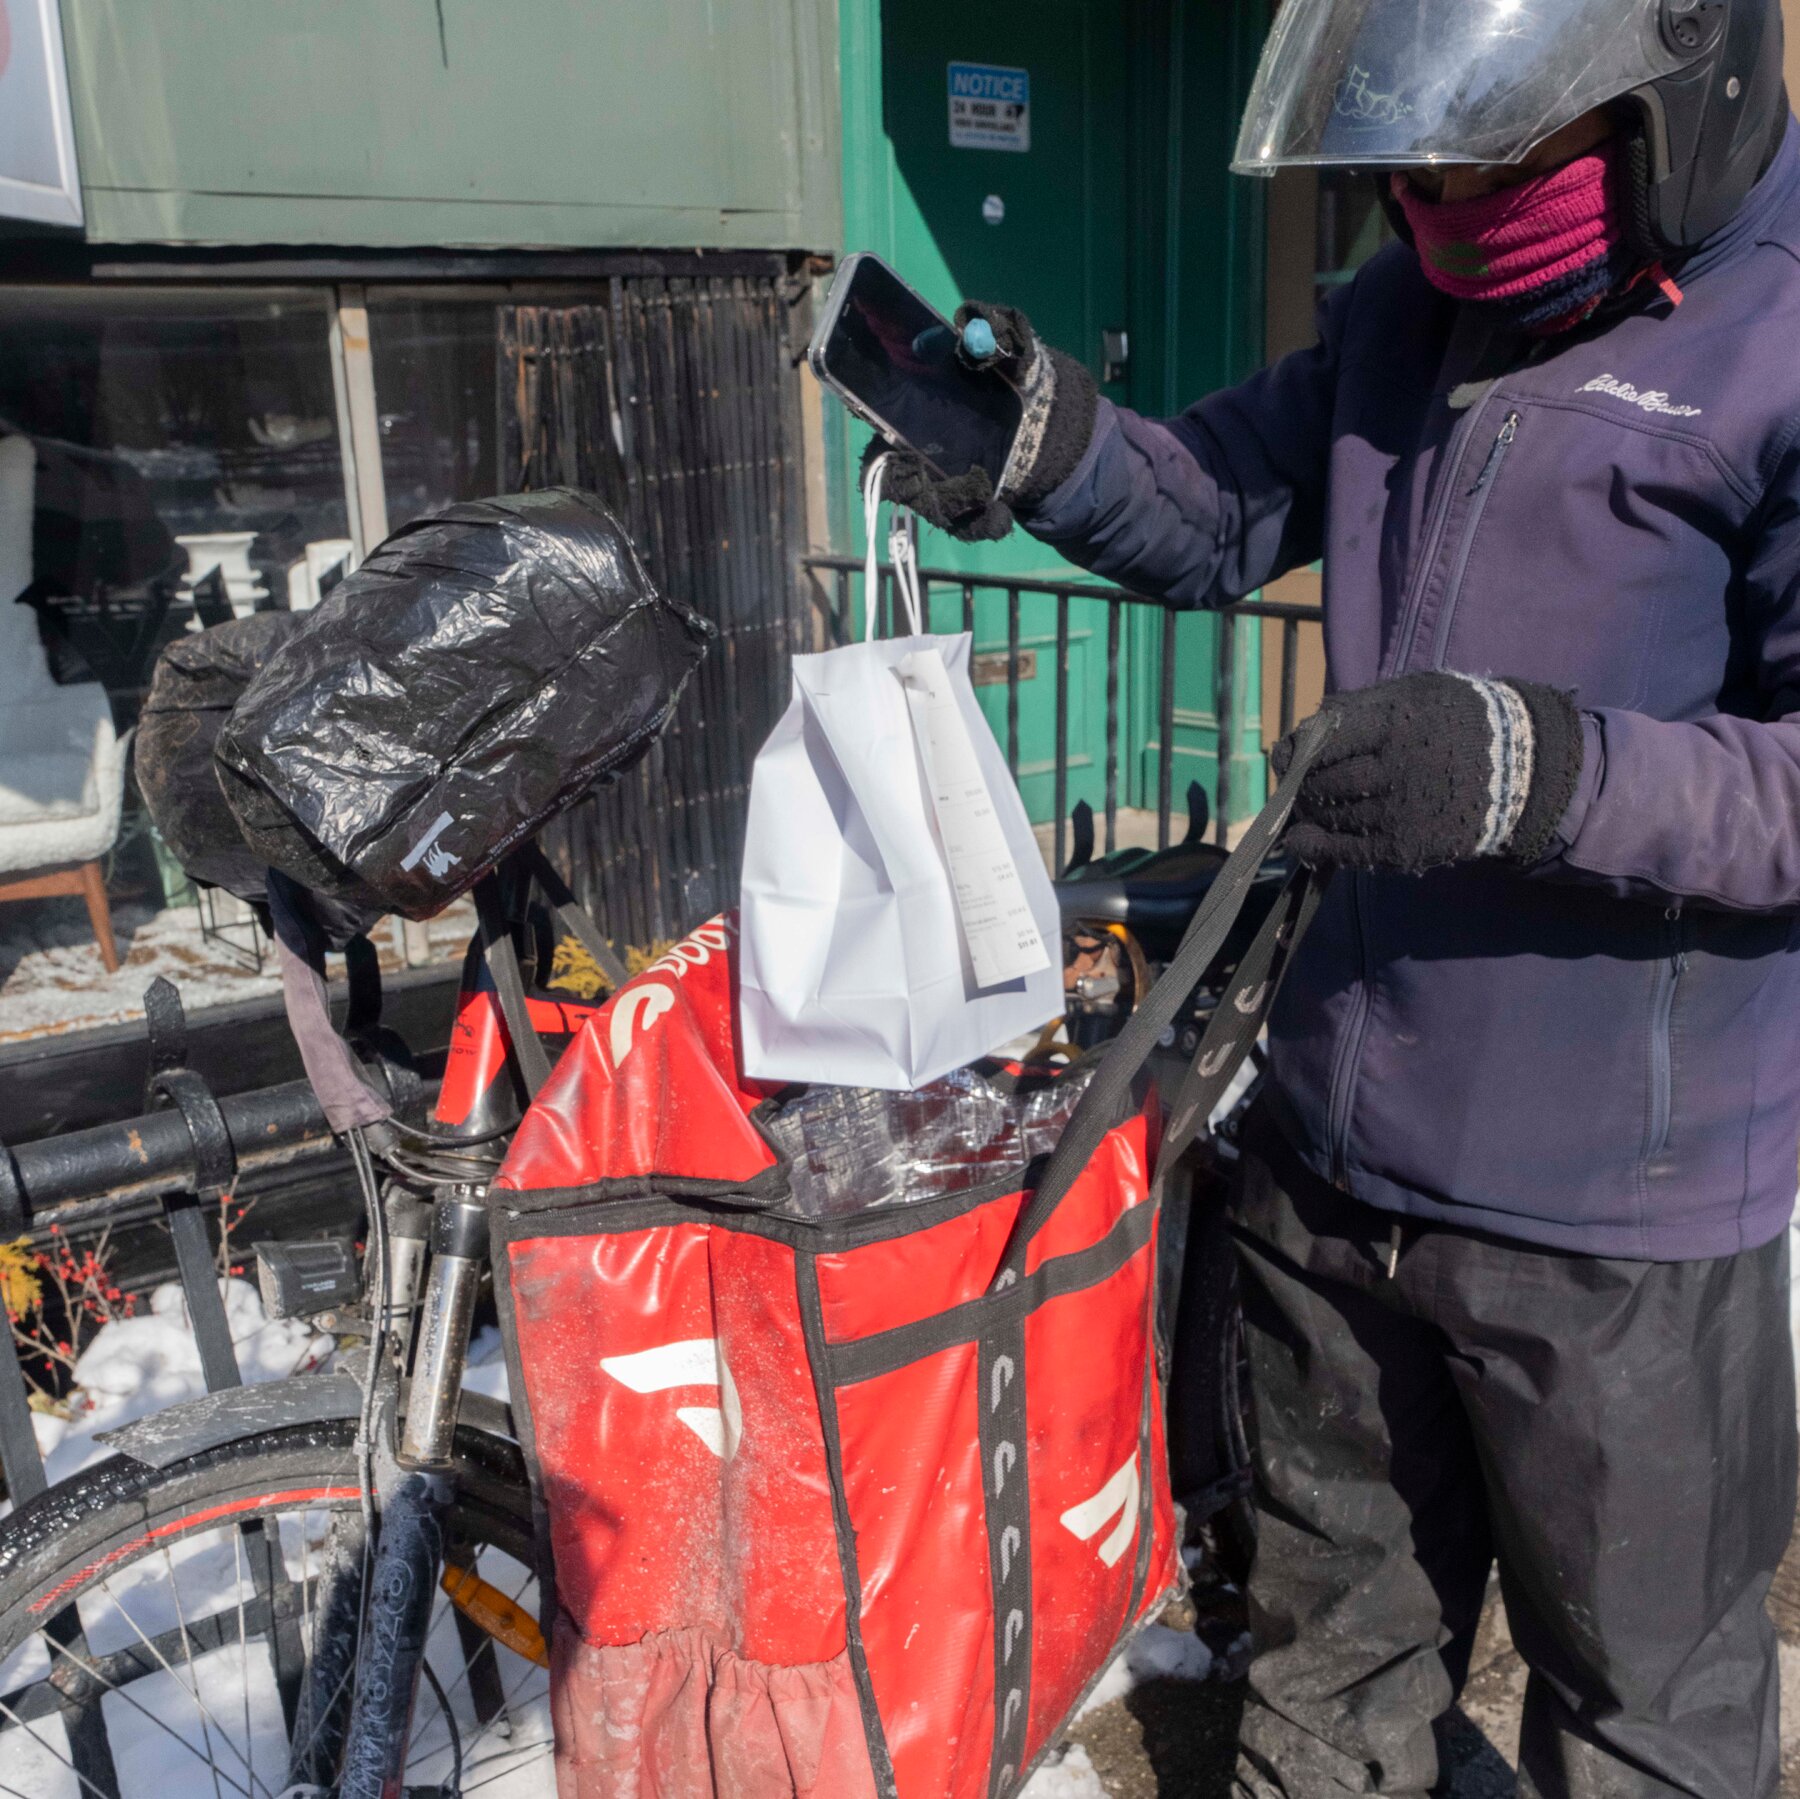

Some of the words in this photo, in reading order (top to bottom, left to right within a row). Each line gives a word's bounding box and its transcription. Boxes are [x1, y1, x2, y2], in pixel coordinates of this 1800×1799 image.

[953, 72, 1023, 99] NOTICE
[1574, 373, 1638, 402] Eddie
[1637, 390, 1702, 417] Bauer
